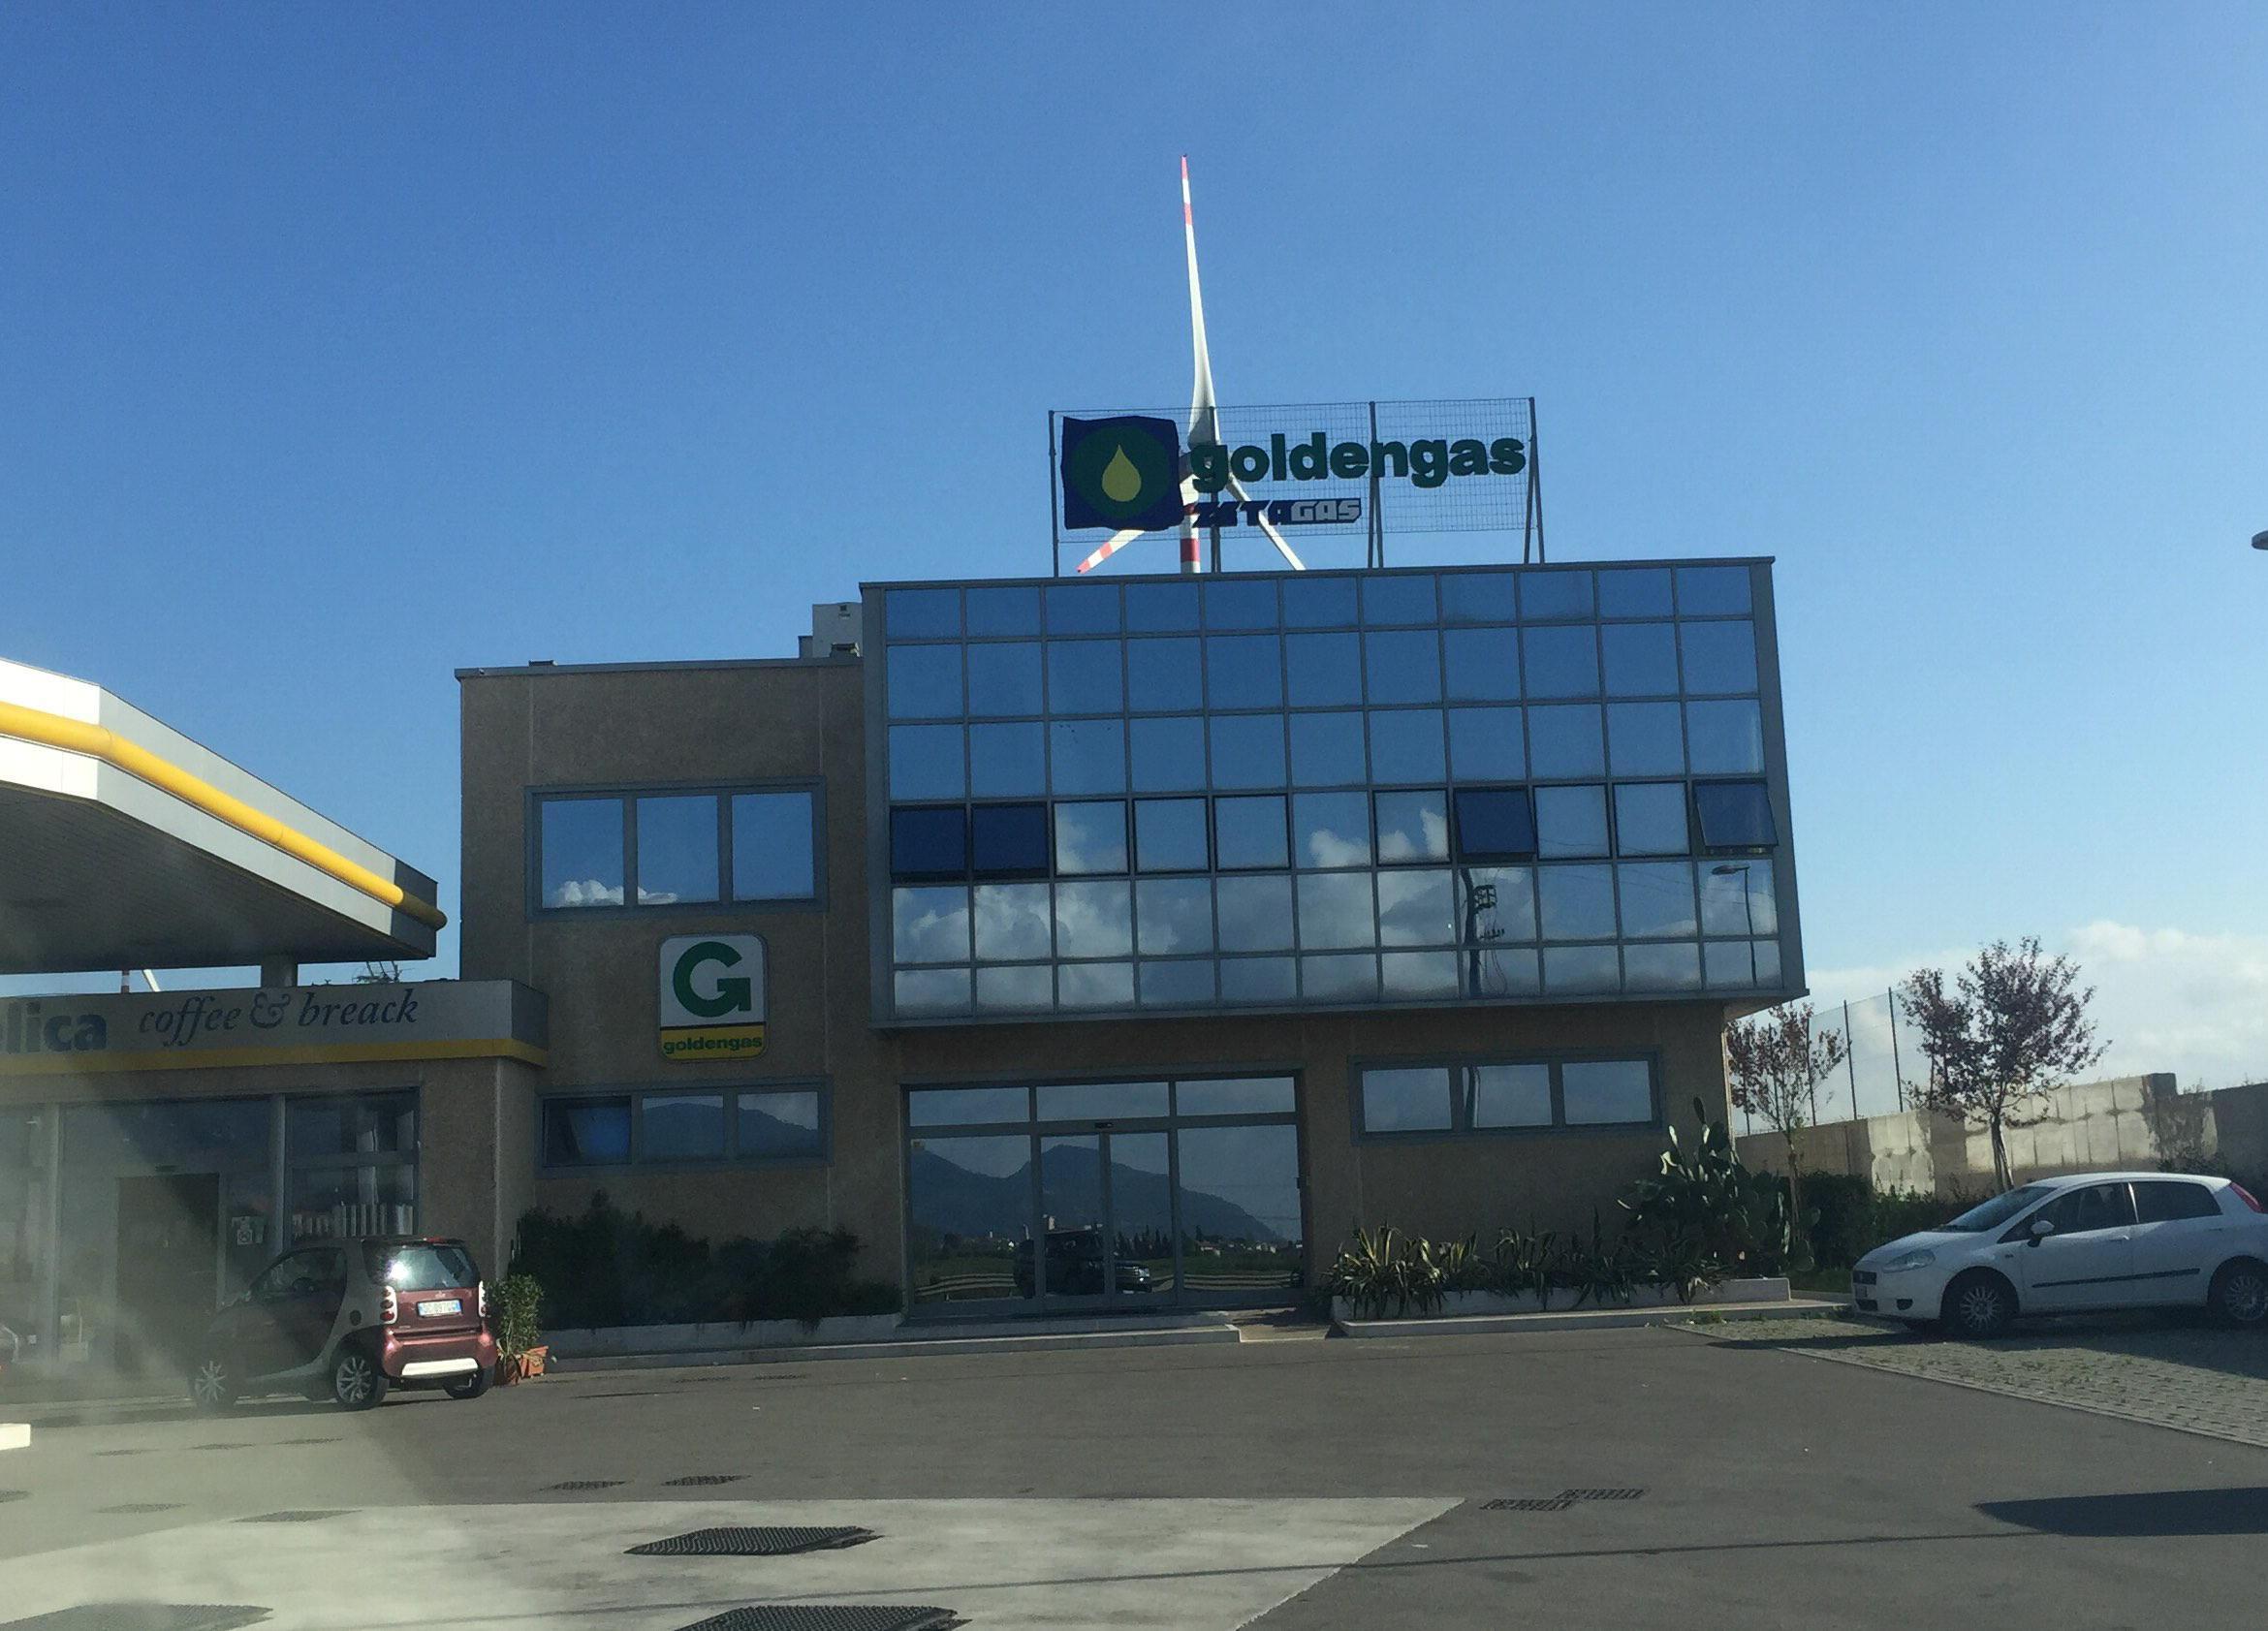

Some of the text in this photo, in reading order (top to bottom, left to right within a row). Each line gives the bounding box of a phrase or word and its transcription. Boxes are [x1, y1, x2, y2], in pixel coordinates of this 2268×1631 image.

[1190, 431, 1526, 492] goldengas
[673, 941, 751, 1018] G
[139, 988, 418, 1048] coffee & breack
[663, 1036, 763, 1054] goldengas
